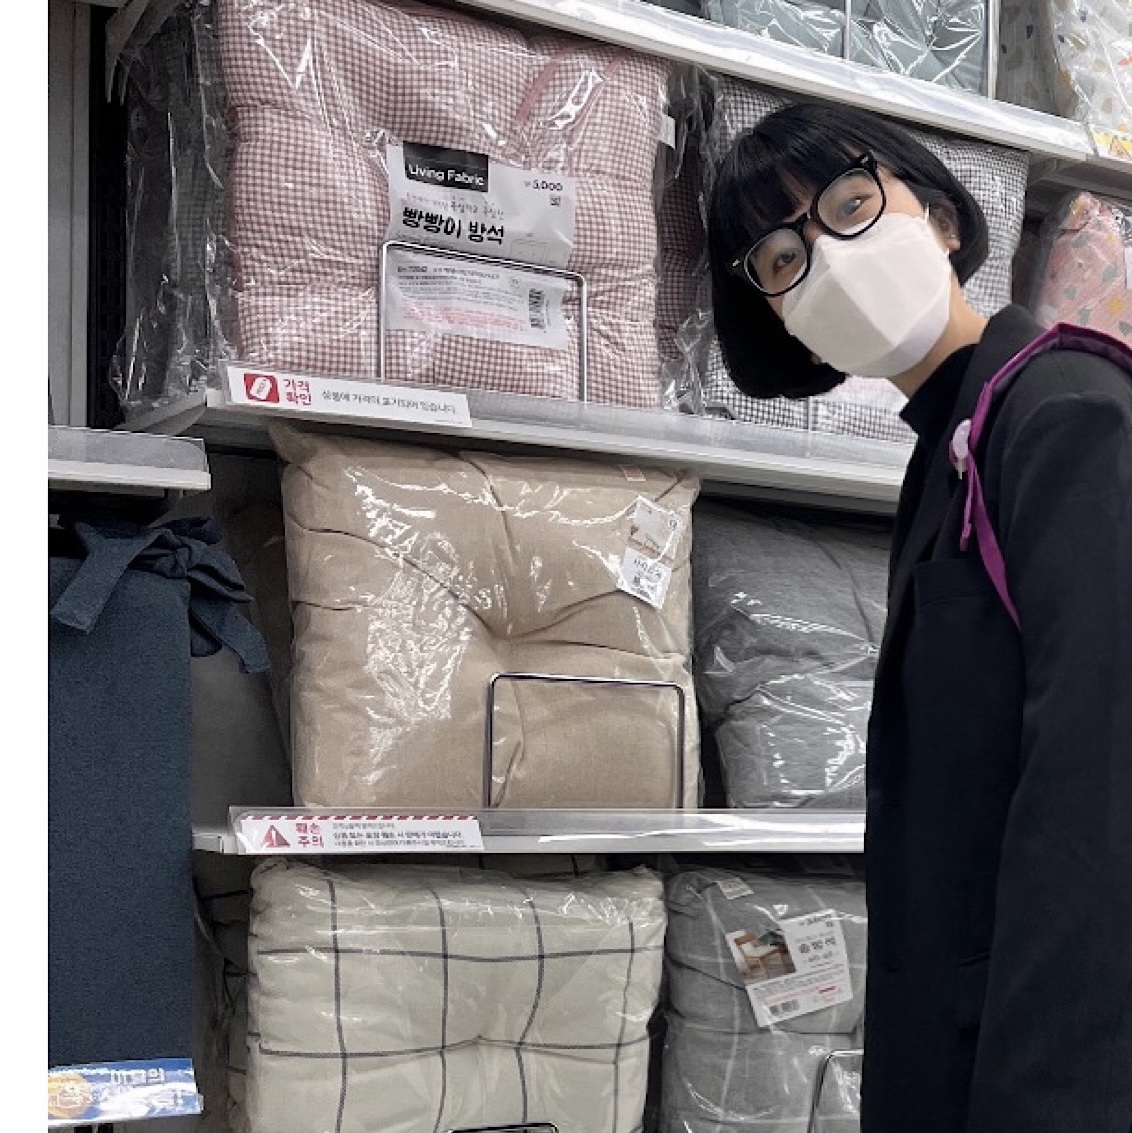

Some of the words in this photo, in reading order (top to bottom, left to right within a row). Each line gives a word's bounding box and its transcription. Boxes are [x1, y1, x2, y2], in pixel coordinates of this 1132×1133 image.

[408, 163, 445, 182] Living
[447, 169, 485, 187] Fabric
[402, 206, 462, 239] 빵빵이
[468, 220, 505, 245] 방석
[283, 378, 310, 393] 가격
[286, 391, 312, 406] 확인
[297, 835, 325, 848] 주의
